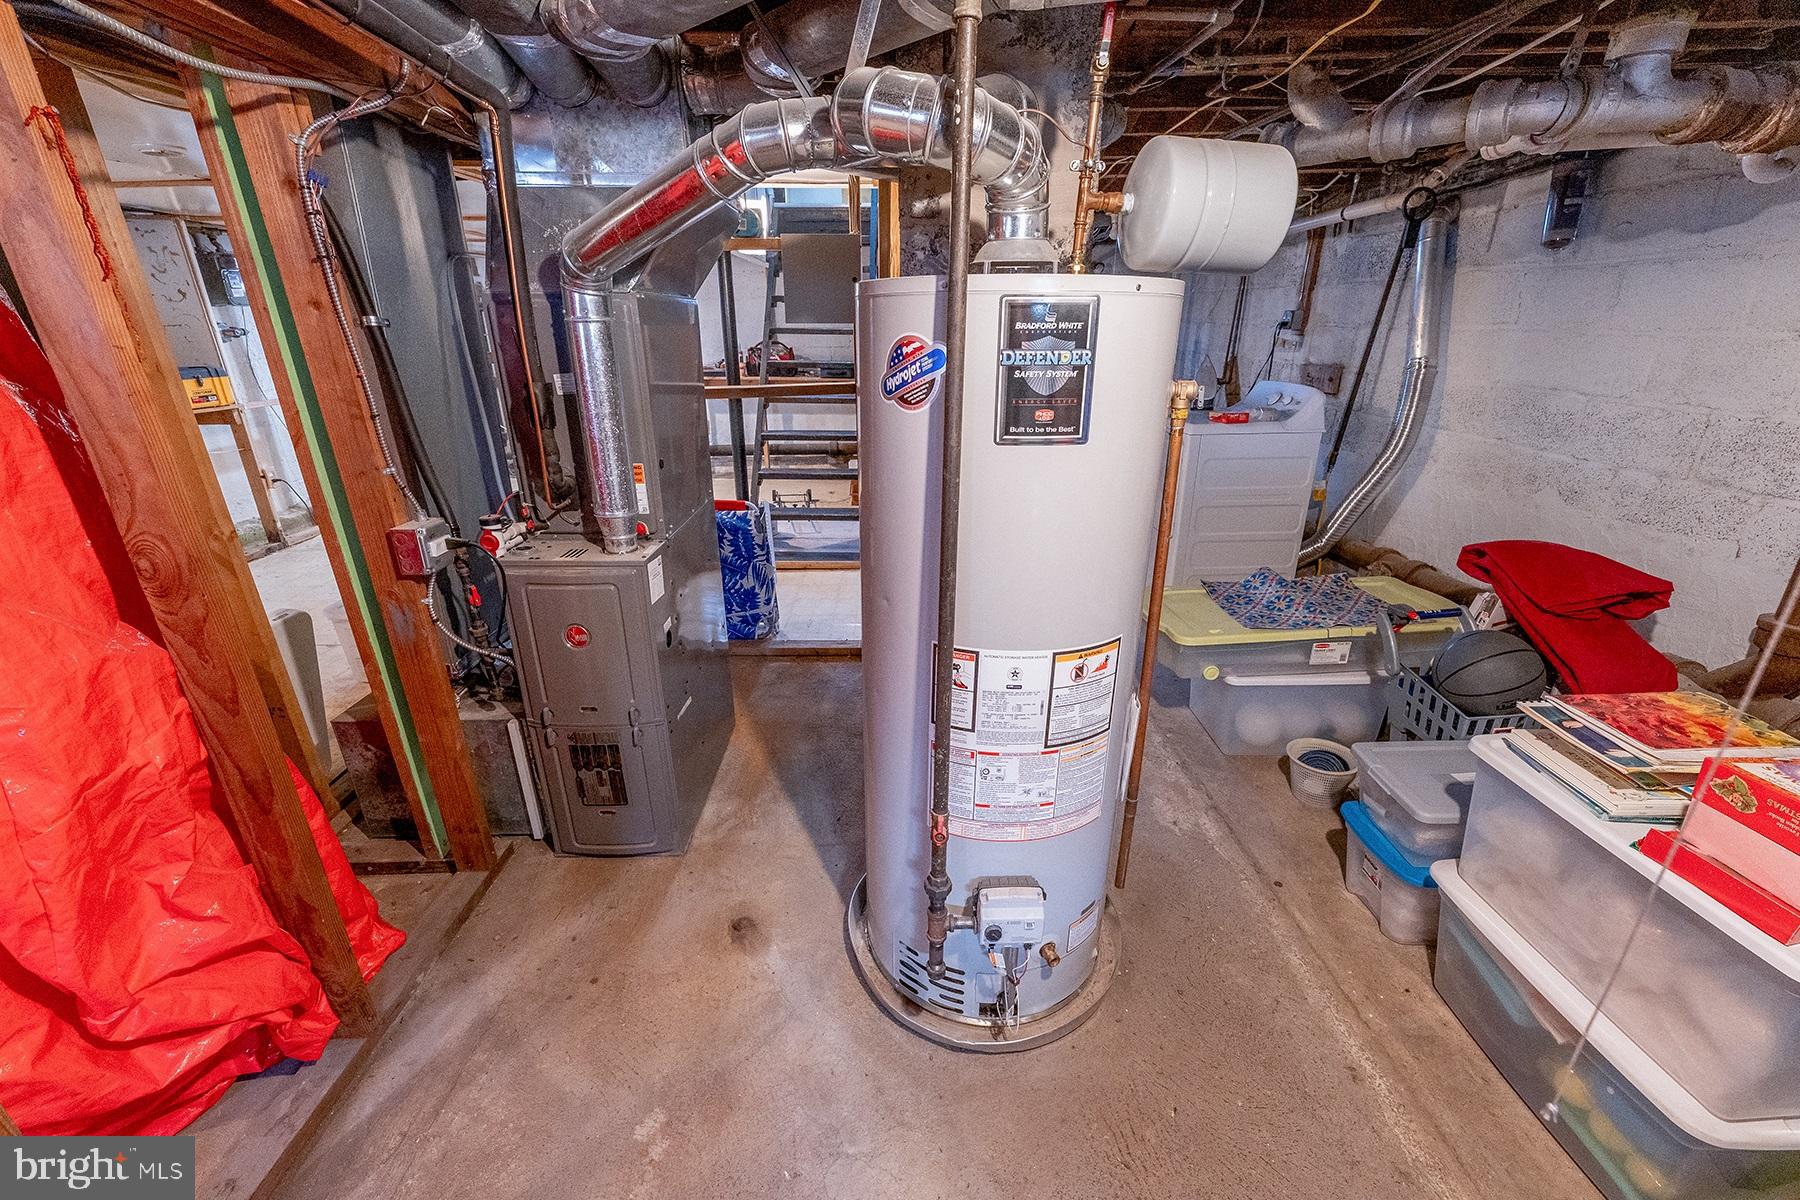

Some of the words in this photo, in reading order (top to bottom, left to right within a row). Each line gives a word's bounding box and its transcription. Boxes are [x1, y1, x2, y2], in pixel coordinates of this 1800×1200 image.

[1015, 321, 1057, 330] BRADFORD
[1058, 321, 1083, 330] WHITE
[1001, 350, 1092, 365] DEFENDER
[886, 359, 922, 392] Hydrojet
[1013, 369, 1043, 378] SAFETY
[1045, 369, 1078, 378] SYSTEM
